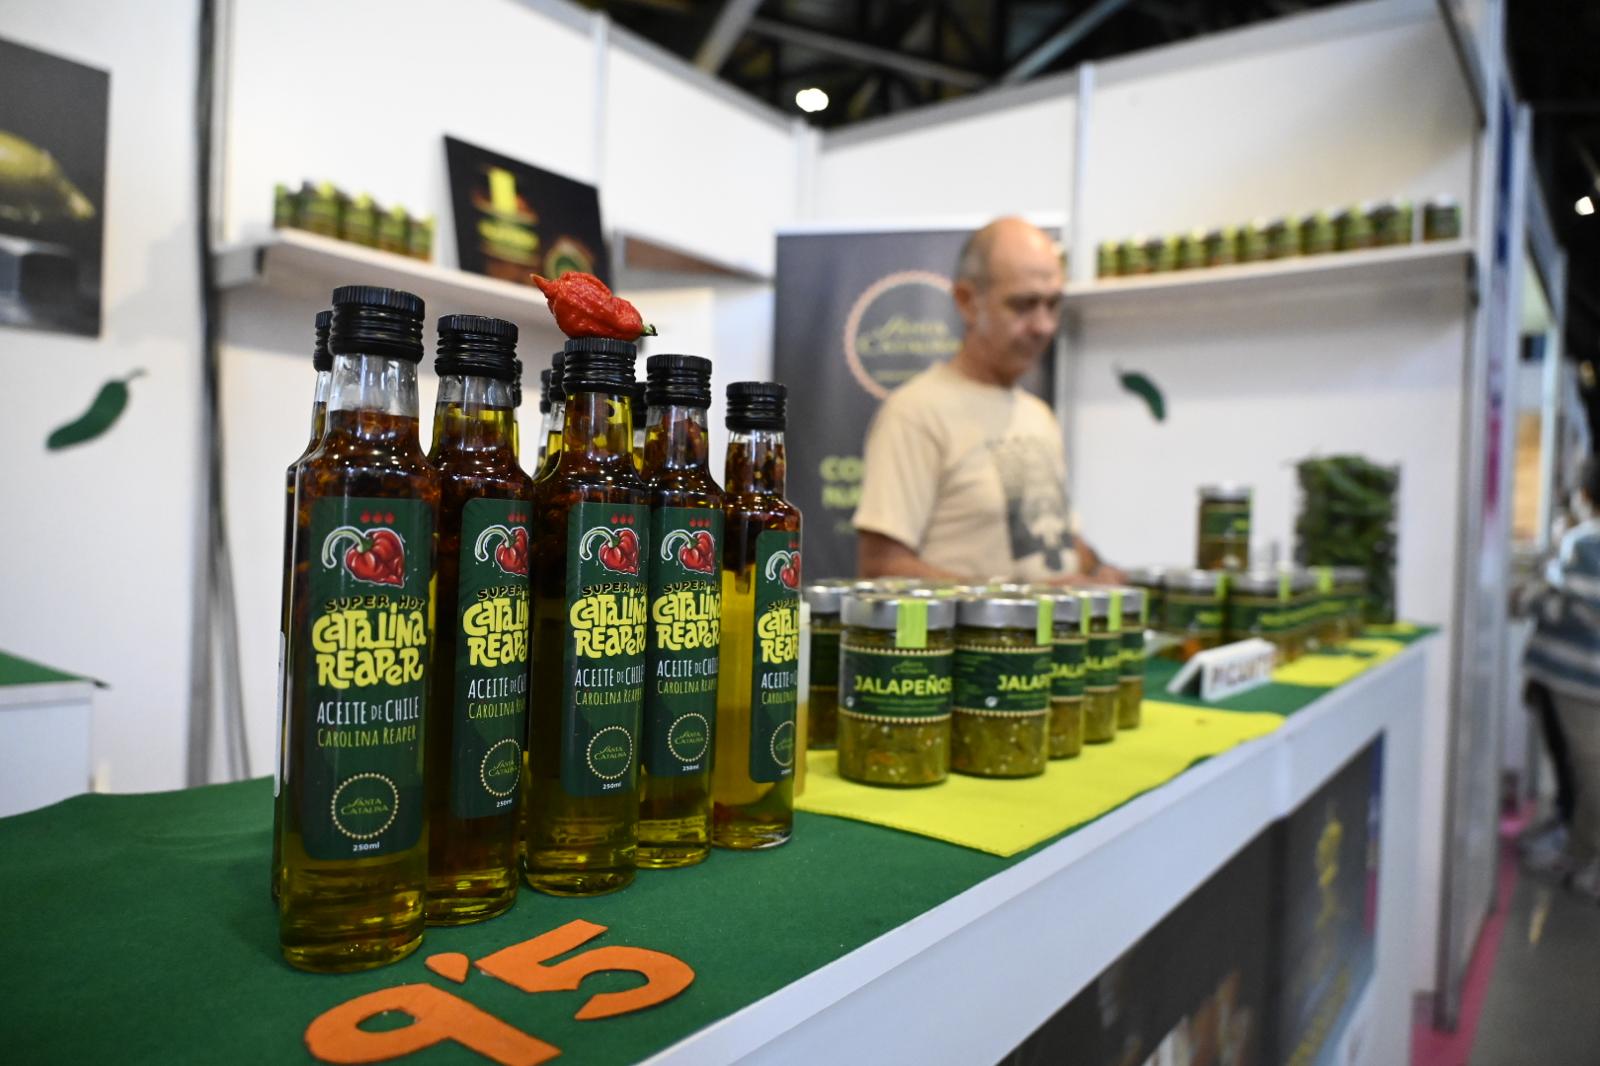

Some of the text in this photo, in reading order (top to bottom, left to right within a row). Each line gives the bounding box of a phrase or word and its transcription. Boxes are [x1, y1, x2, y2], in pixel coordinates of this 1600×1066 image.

[582, 582, 630, 597] SUPER
[664, 580, 707, 594] SUPER
[325, 595, 425, 612] SUPER HOT
[656, 659, 693, 678] ACEITE
[575, 668, 614, 687] ACEITE
[761, 671, 790, 689] ACEITE
[468, 677, 509, 699] ACEITE
[658, 680, 700, 694] CAROLINA
[575, 690, 621, 705] CAROLINA
[317, 701, 367, 725] ACEITE
[385, 696, 419, 722] CHILE
[317, 724, 417, 748] CAROLINA REAPER
[602, 781, 622, 790] 250ml
[353, 841, 381, 852] 250ml
